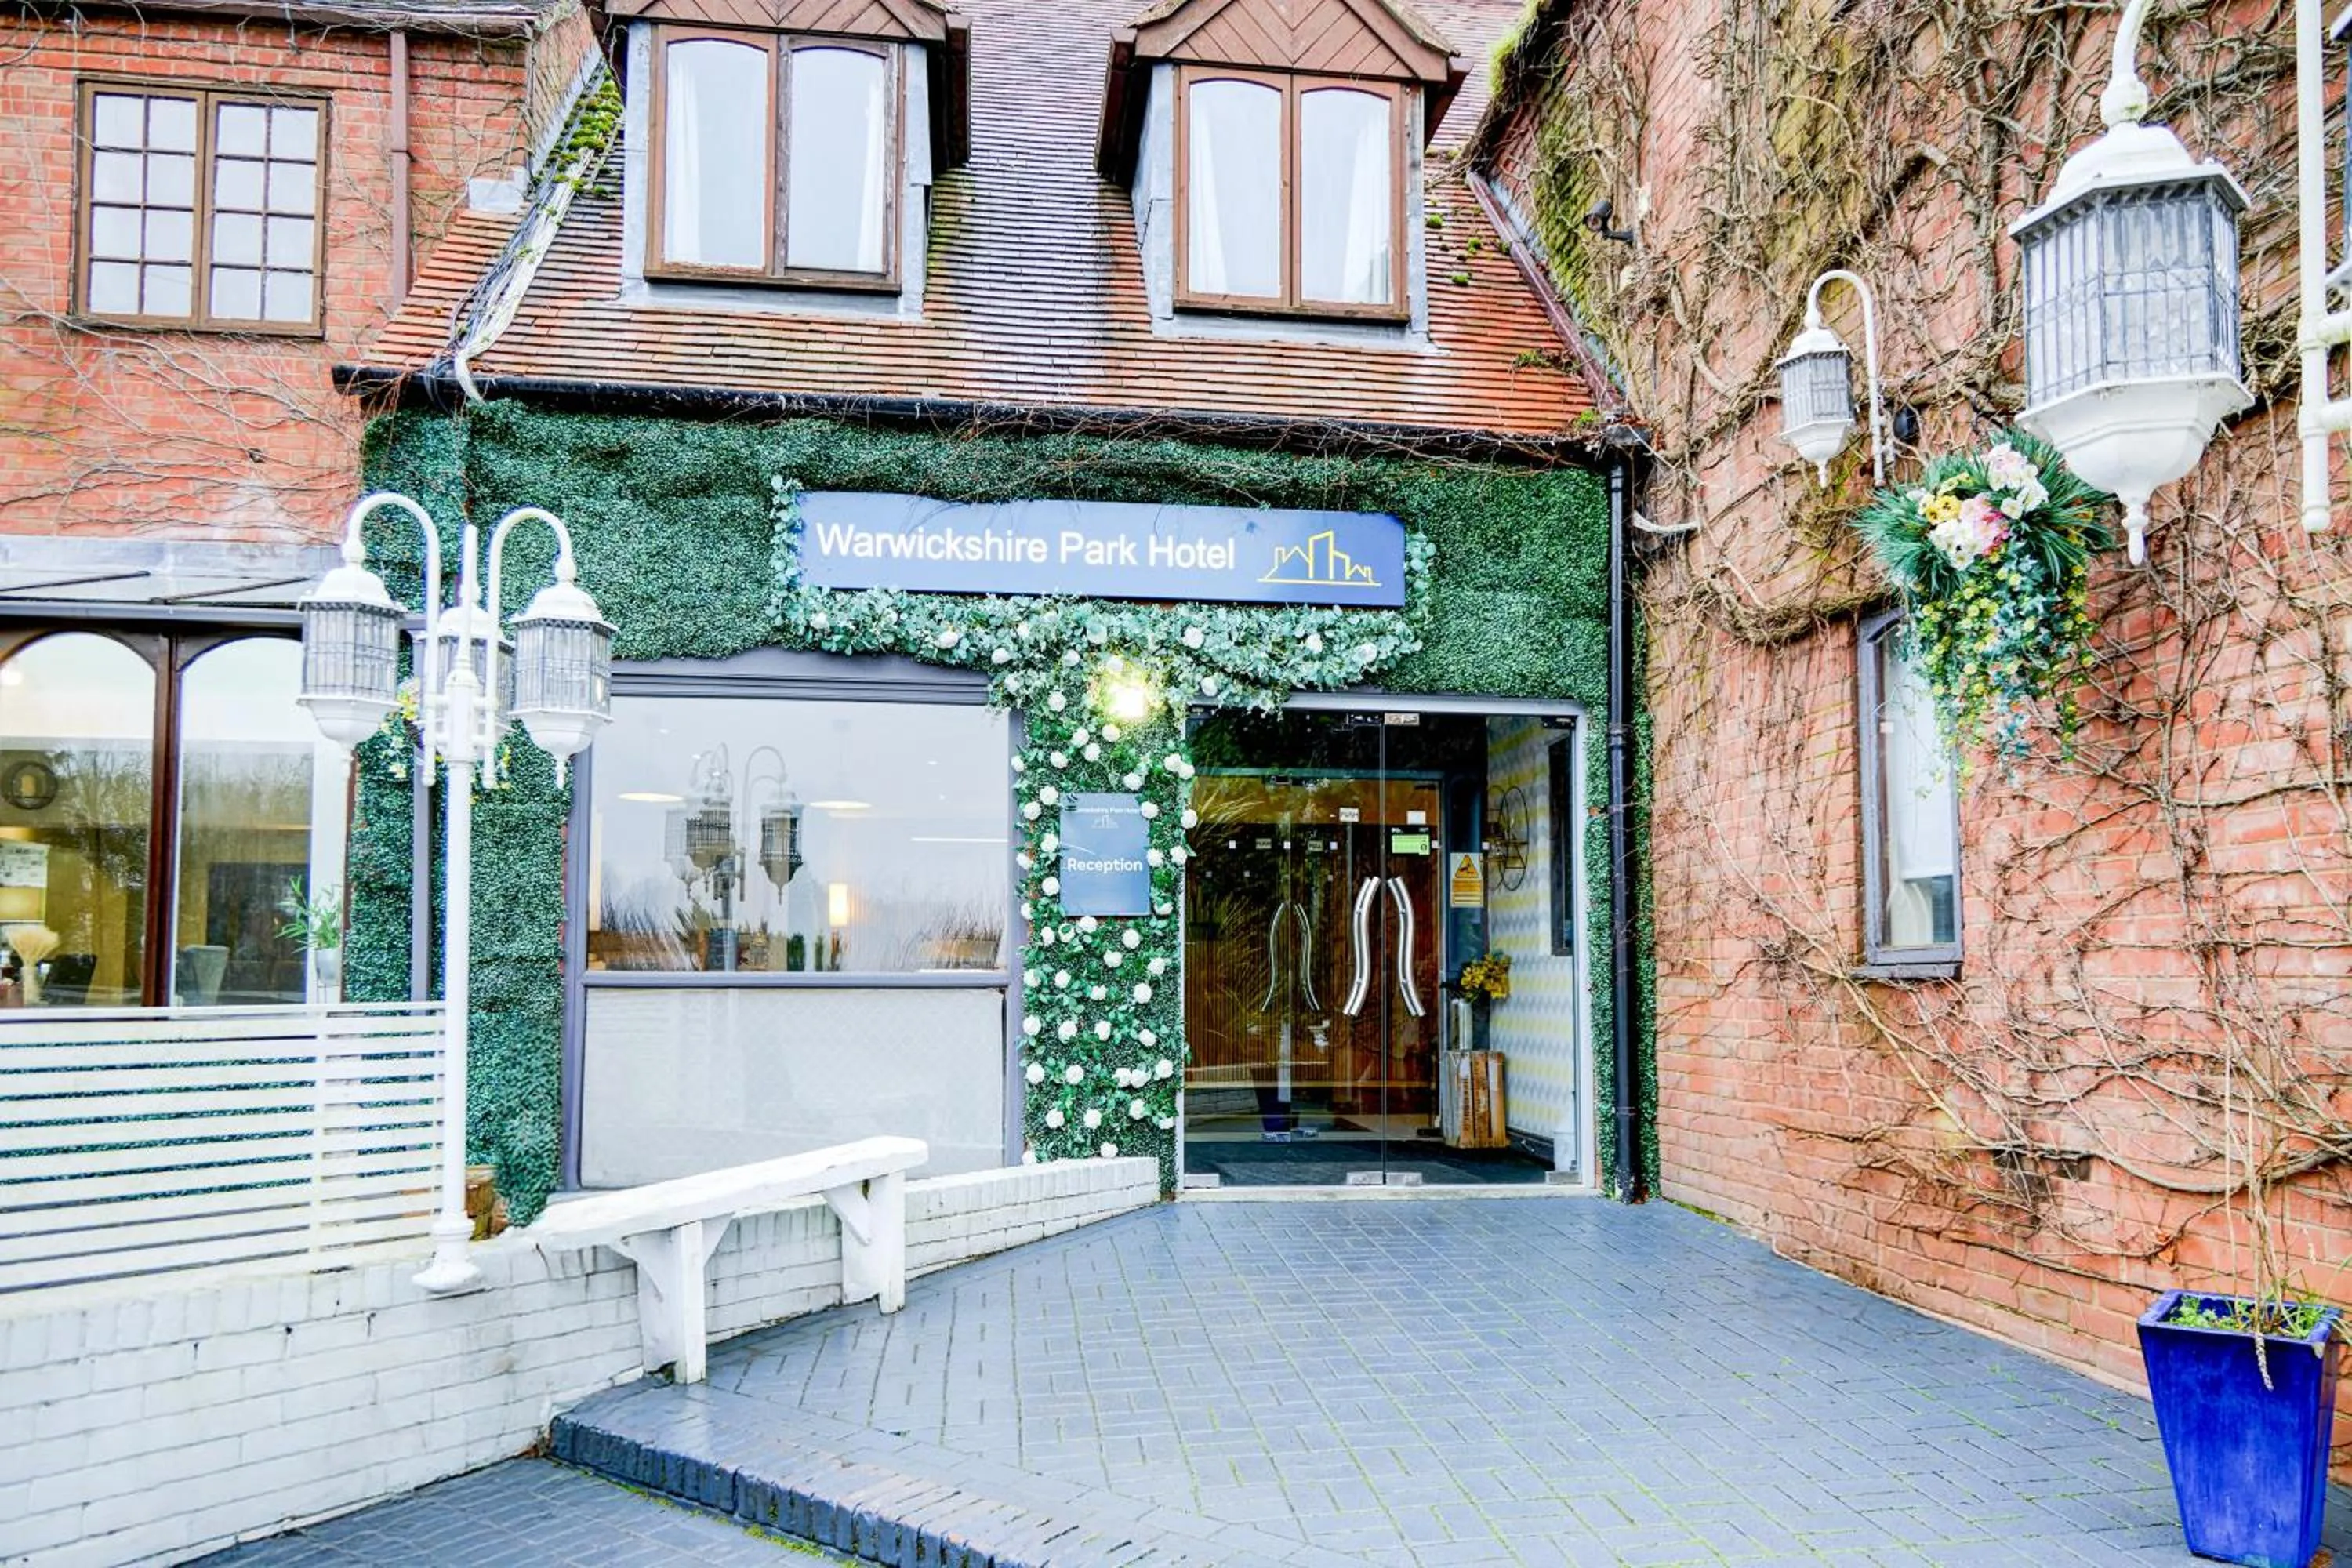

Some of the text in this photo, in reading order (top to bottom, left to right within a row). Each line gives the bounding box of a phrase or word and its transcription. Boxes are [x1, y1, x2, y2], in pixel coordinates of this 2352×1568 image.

[815, 522, 1236, 570] Warwickshire Park Hotel
[1067, 858, 1142, 873] Reception
